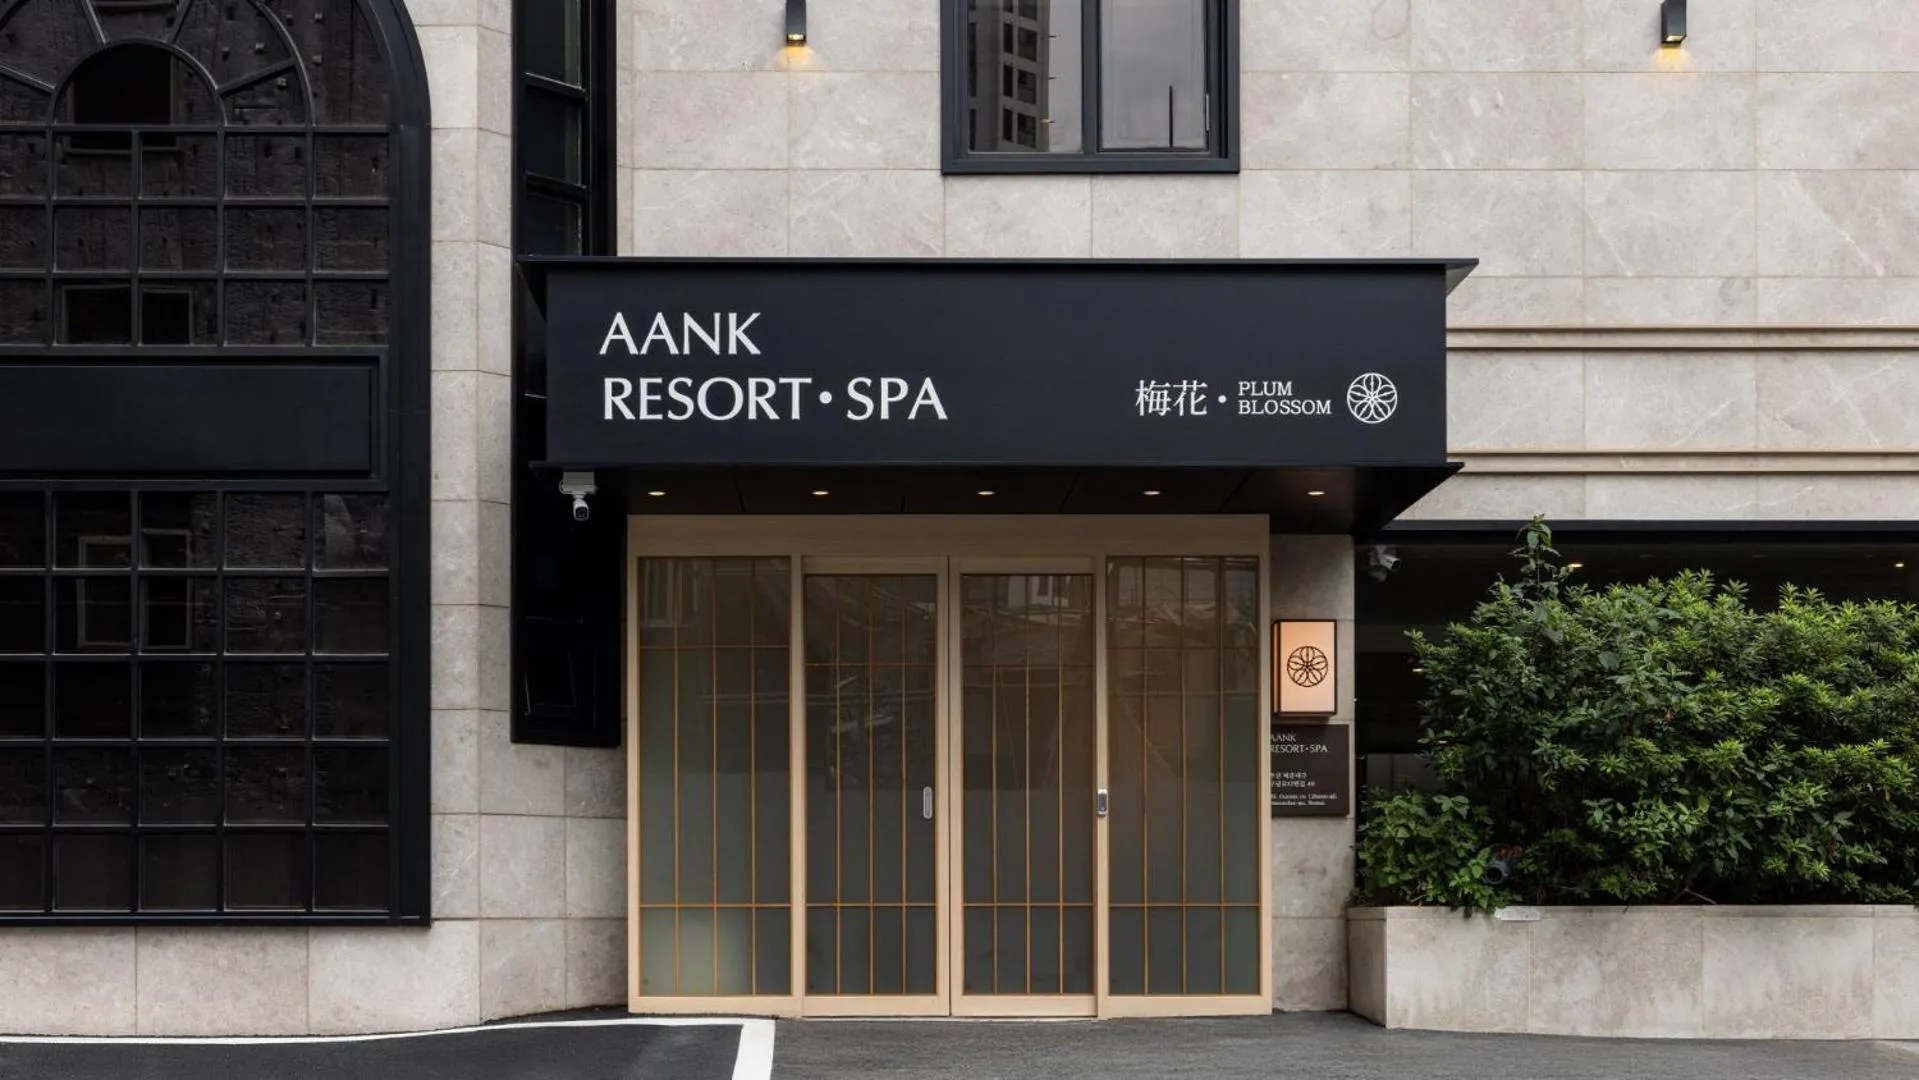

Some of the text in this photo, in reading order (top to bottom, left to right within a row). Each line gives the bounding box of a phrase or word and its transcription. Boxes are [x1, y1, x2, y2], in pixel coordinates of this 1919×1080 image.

[599, 311, 762, 355] AANK
[603, 376, 949, 421] RESORT SPA
[1135, 379, 1208, 417] 梅花
[1237, 381, 1293, 397] PLUM
[1237, 399, 1333, 415] BLOSSOM
